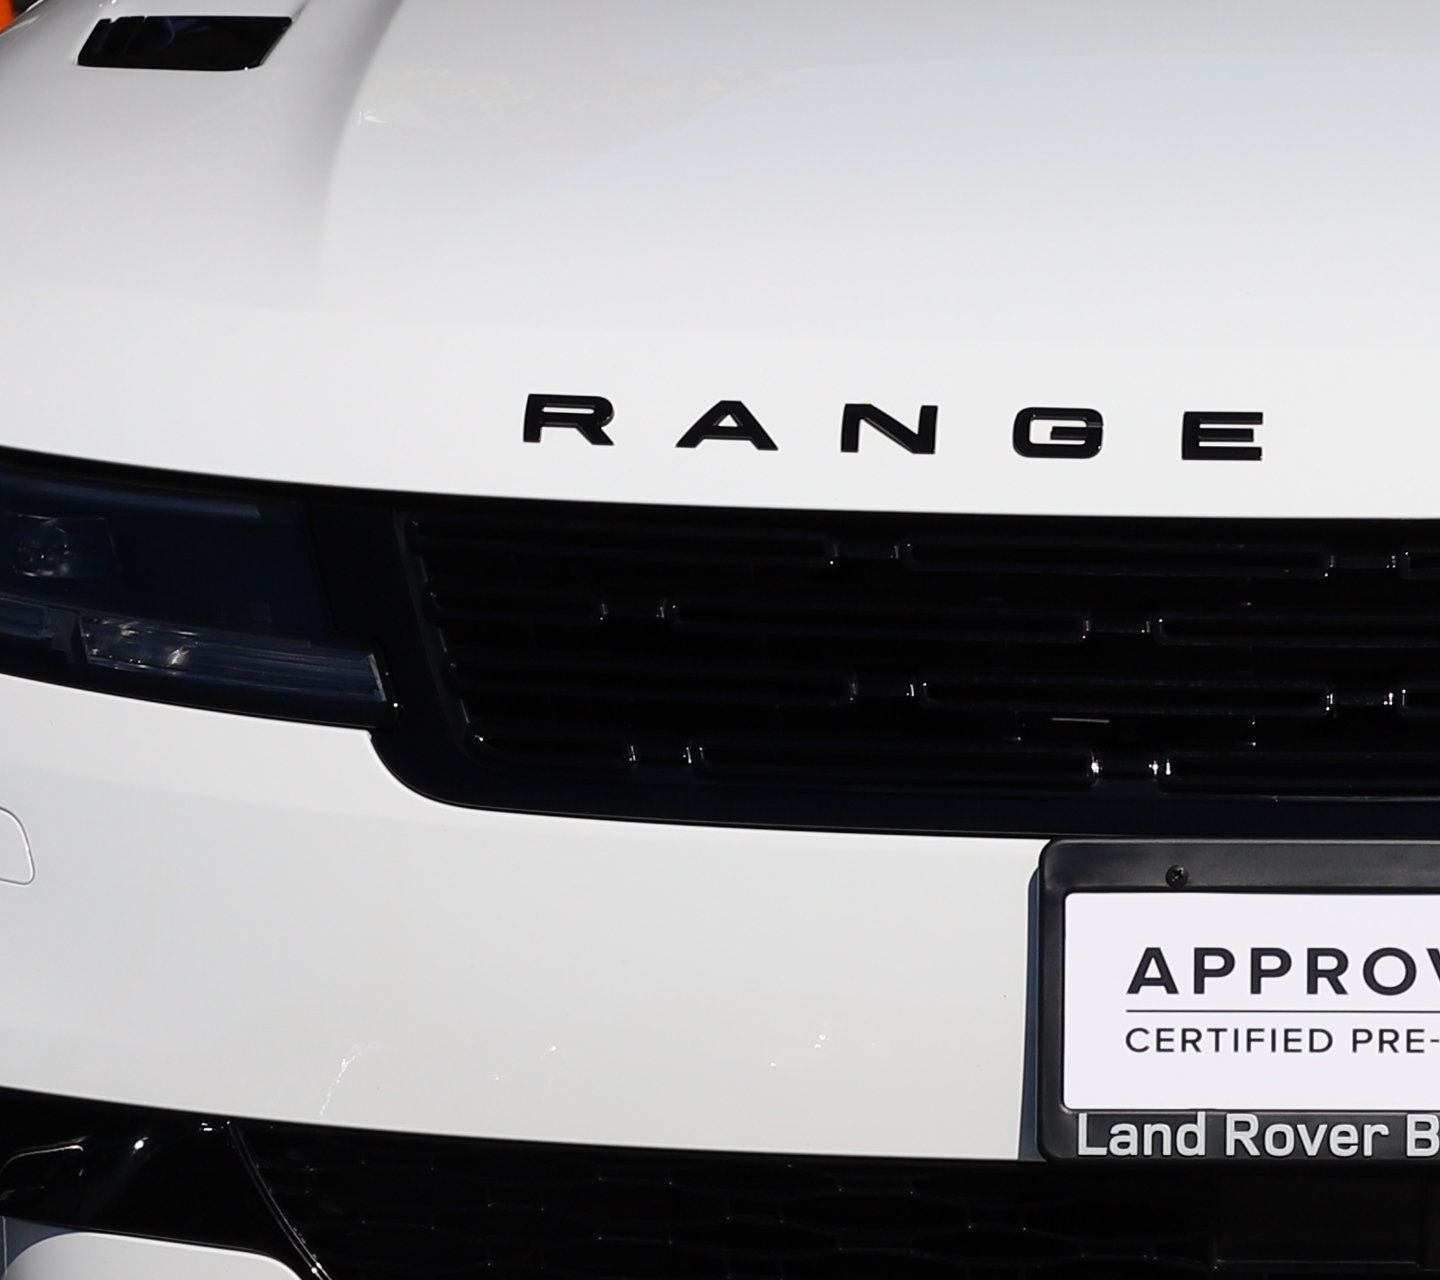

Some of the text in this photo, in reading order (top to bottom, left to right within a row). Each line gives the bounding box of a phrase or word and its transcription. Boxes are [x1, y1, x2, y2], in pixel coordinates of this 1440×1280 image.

[523, 393, 1265, 461] RANGE
[1125, 1027, 1334, 1054] CERTIFIED
[1077, 1111, 1207, 1157] Land
[1224, 1112, 1390, 1158] Rover
